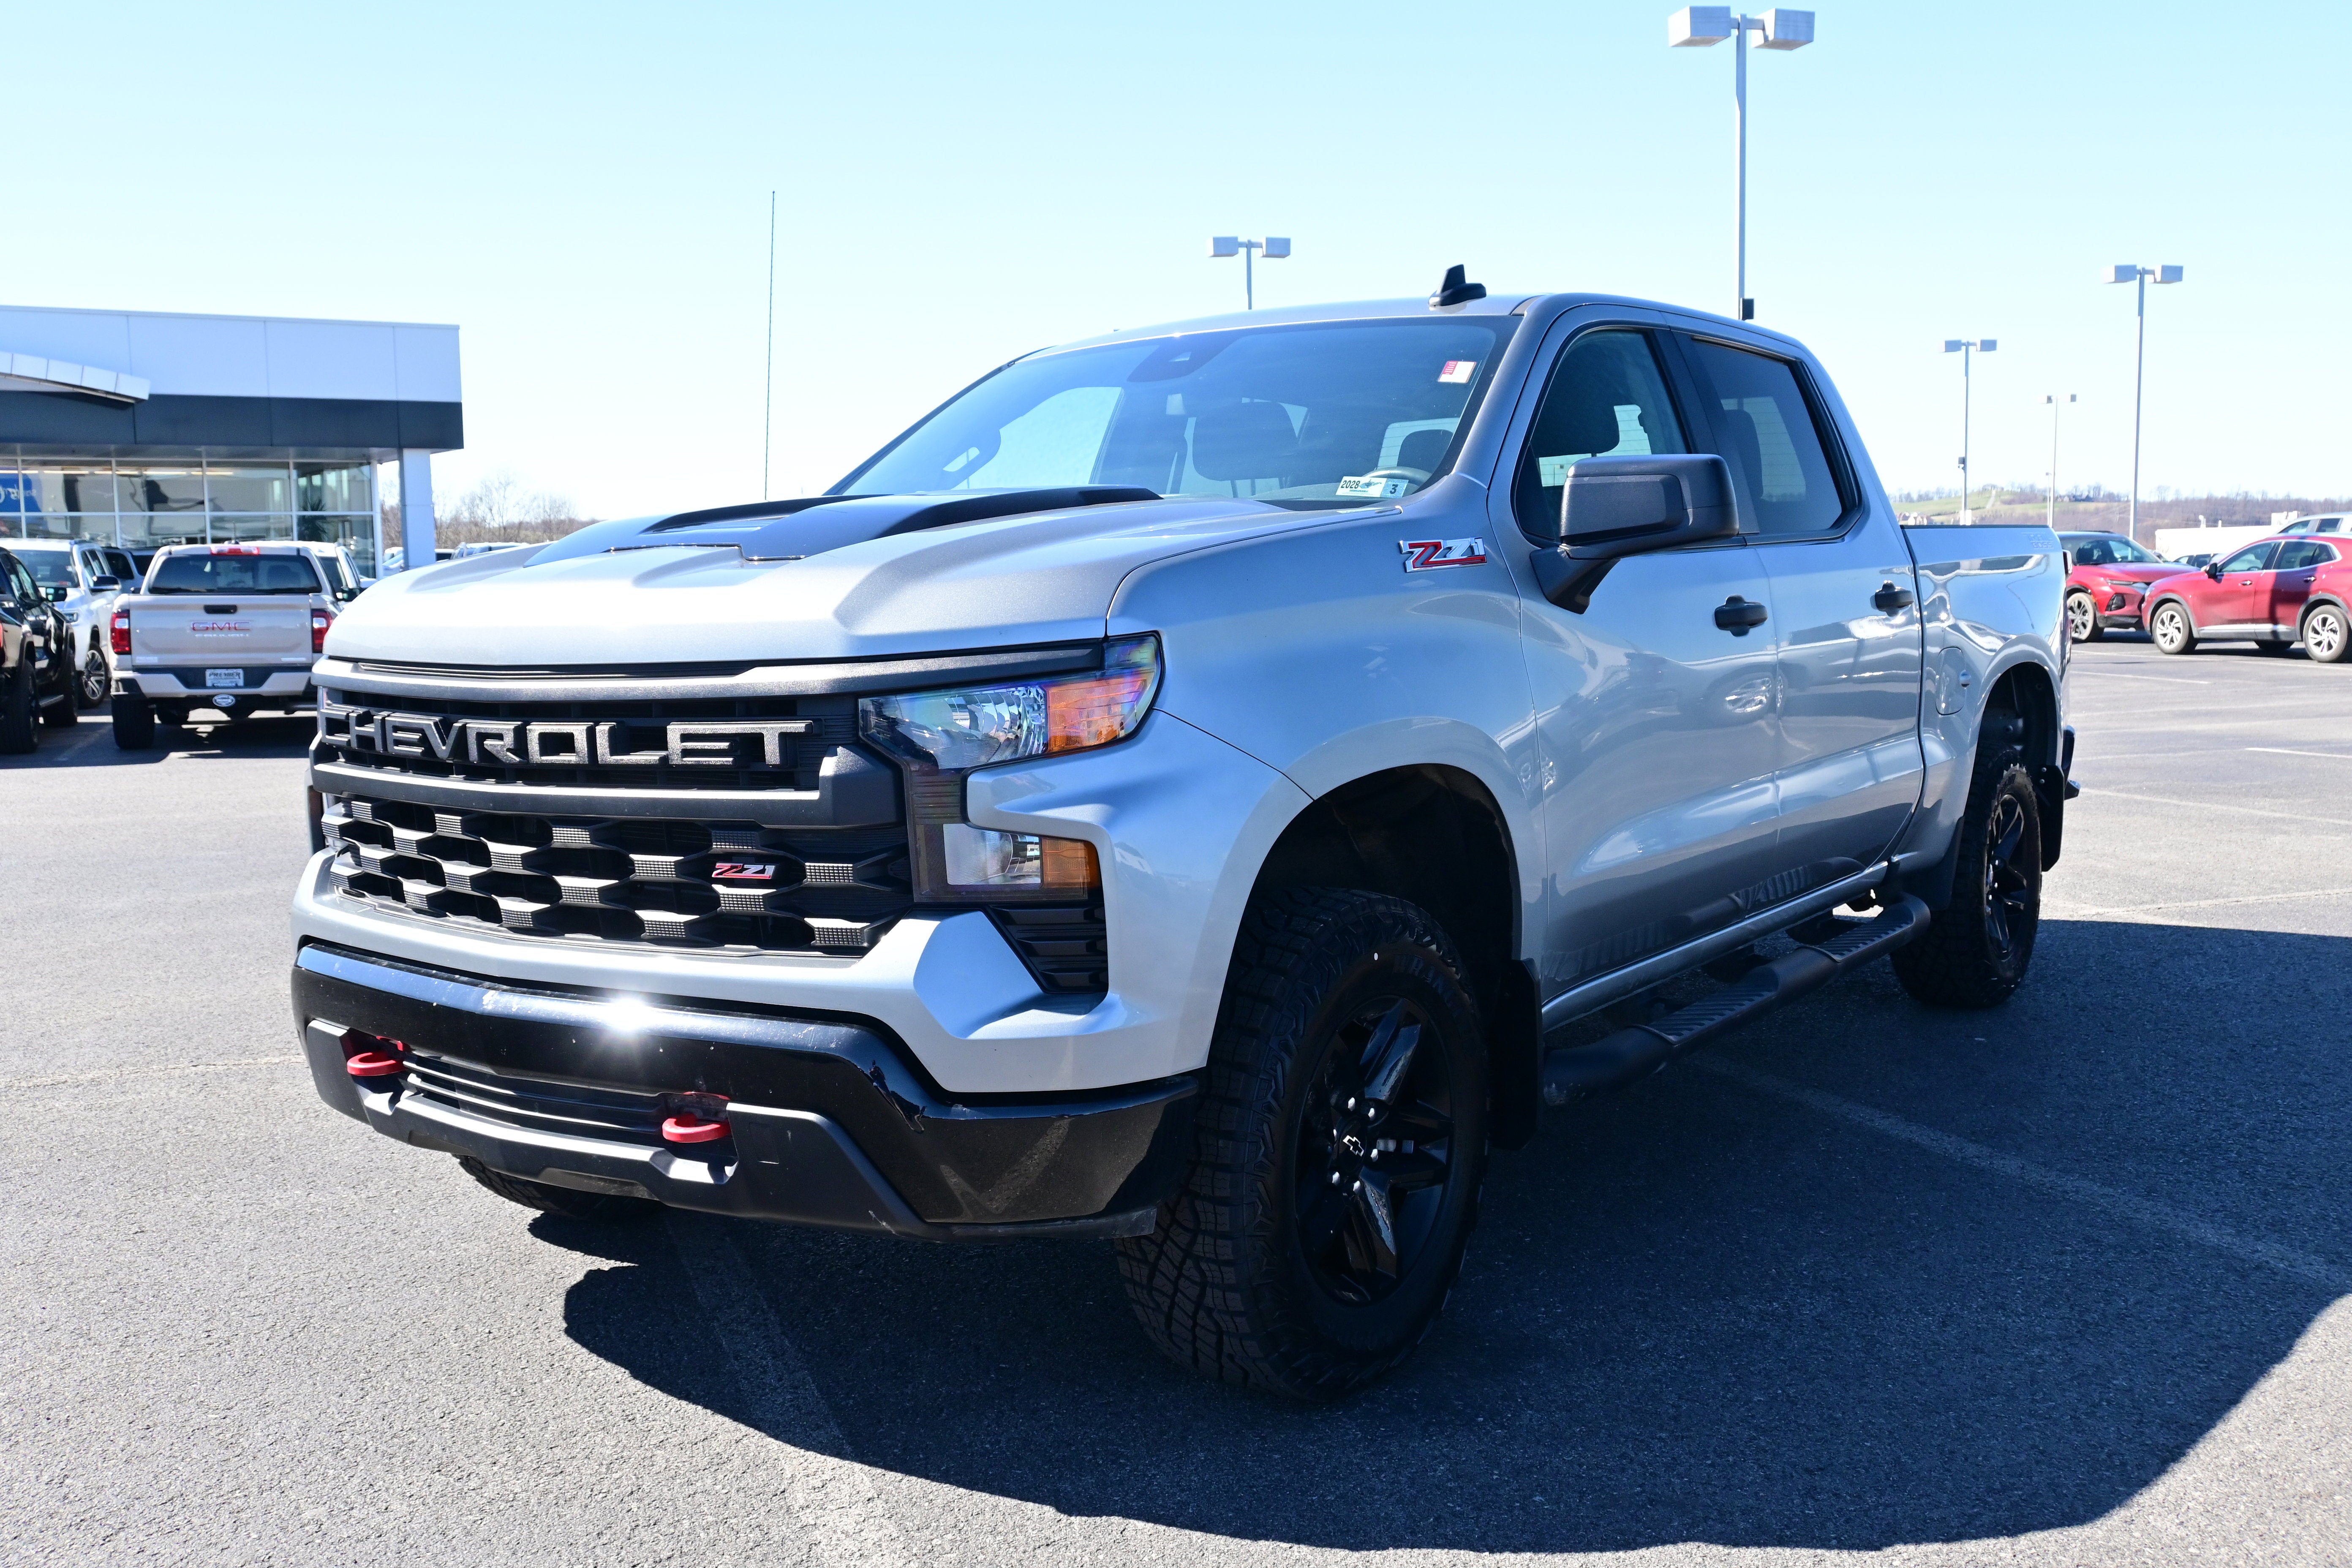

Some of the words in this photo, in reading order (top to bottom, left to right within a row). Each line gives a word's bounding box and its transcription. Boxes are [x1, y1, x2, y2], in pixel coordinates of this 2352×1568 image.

[1341, 480, 1361, 489] 2028
[1389, 484, 1399, 494] 3
[1399, 537, 1487, 572] Z71
[191, 622, 251, 631] GMC
[319, 705, 813, 766] CHEVROLET
[712, 863, 777, 879] Z71
